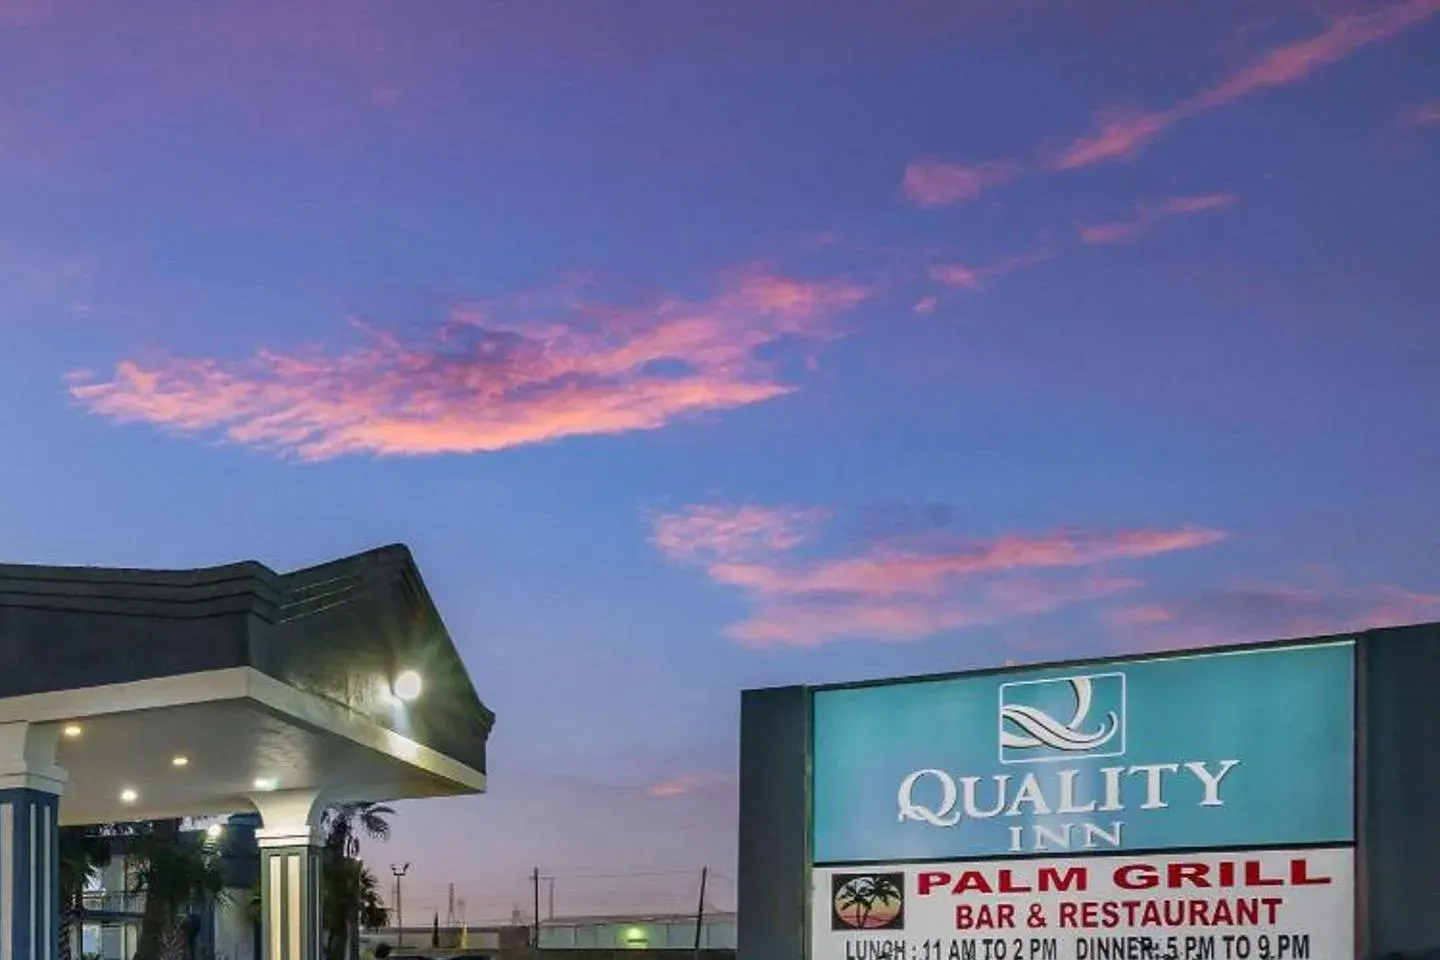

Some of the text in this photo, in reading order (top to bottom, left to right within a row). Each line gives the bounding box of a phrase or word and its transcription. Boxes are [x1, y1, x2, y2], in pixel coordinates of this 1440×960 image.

[897, 760, 1240, 828] QUALITY
[1008, 821, 1126, 852] INN
[916, 859, 1332, 896] PALM GRILL
[955, 898, 1283, 930] BAR & RESTAURANT
[922, 938, 942, 960] 11
[947, 938, 976, 960] AM
[1012, 937, 1024, 960] 2
[1030, 937, 1058, 960] PM
[1166, 936, 1178, 960] 5
[1185, 936, 1215, 960] PM
[1222, 935, 1251, 960] TO
[1258, 934, 1270, 959] 9
[1278, 934, 1310, 959] PM
